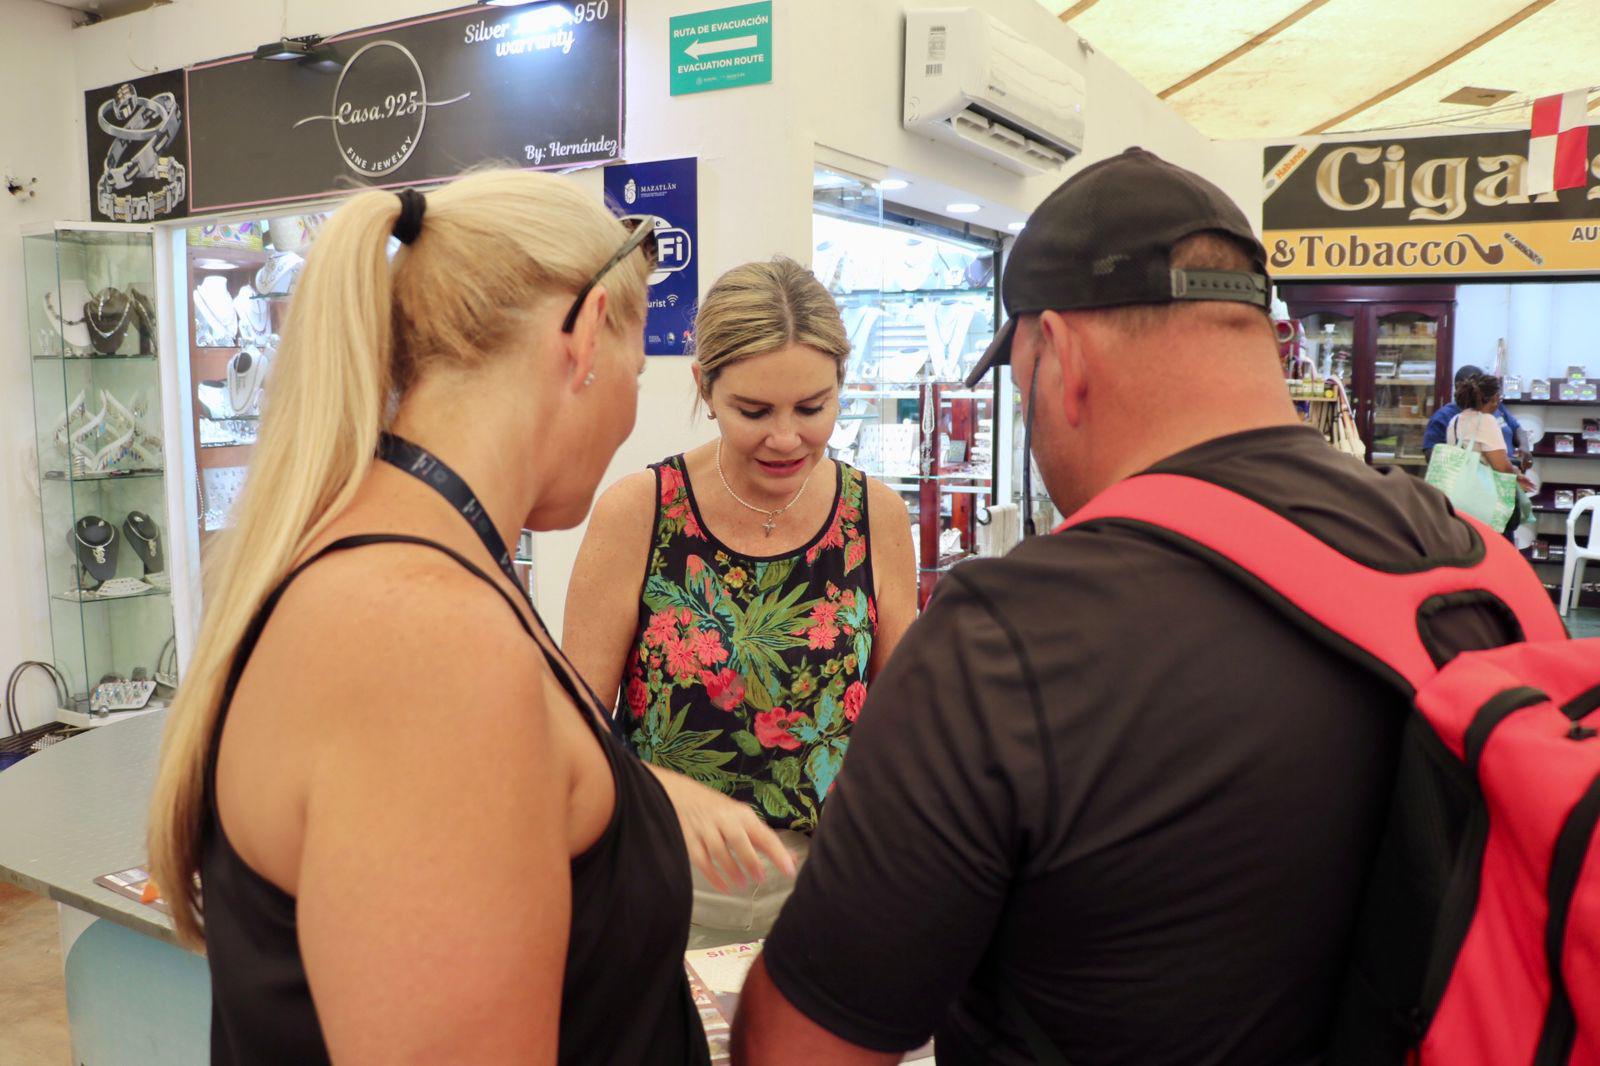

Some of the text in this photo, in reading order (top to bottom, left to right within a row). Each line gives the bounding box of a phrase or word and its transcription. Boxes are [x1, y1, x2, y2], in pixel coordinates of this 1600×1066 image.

[464, 20, 511, 44] Silver
[673, 15, 769, 39] RUTA DE EVACUACIÓN
[677, 53, 765, 75] EVACUATION ROUTE
[338, 91, 418, 125] Casa.925
[346, 136, 412, 171] FINE JEWELRY
[524, 135, 619, 165] By: Hernández
[1315, 144, 1600, 222] Ciga
[1571, 226, 1600, 241] AU
